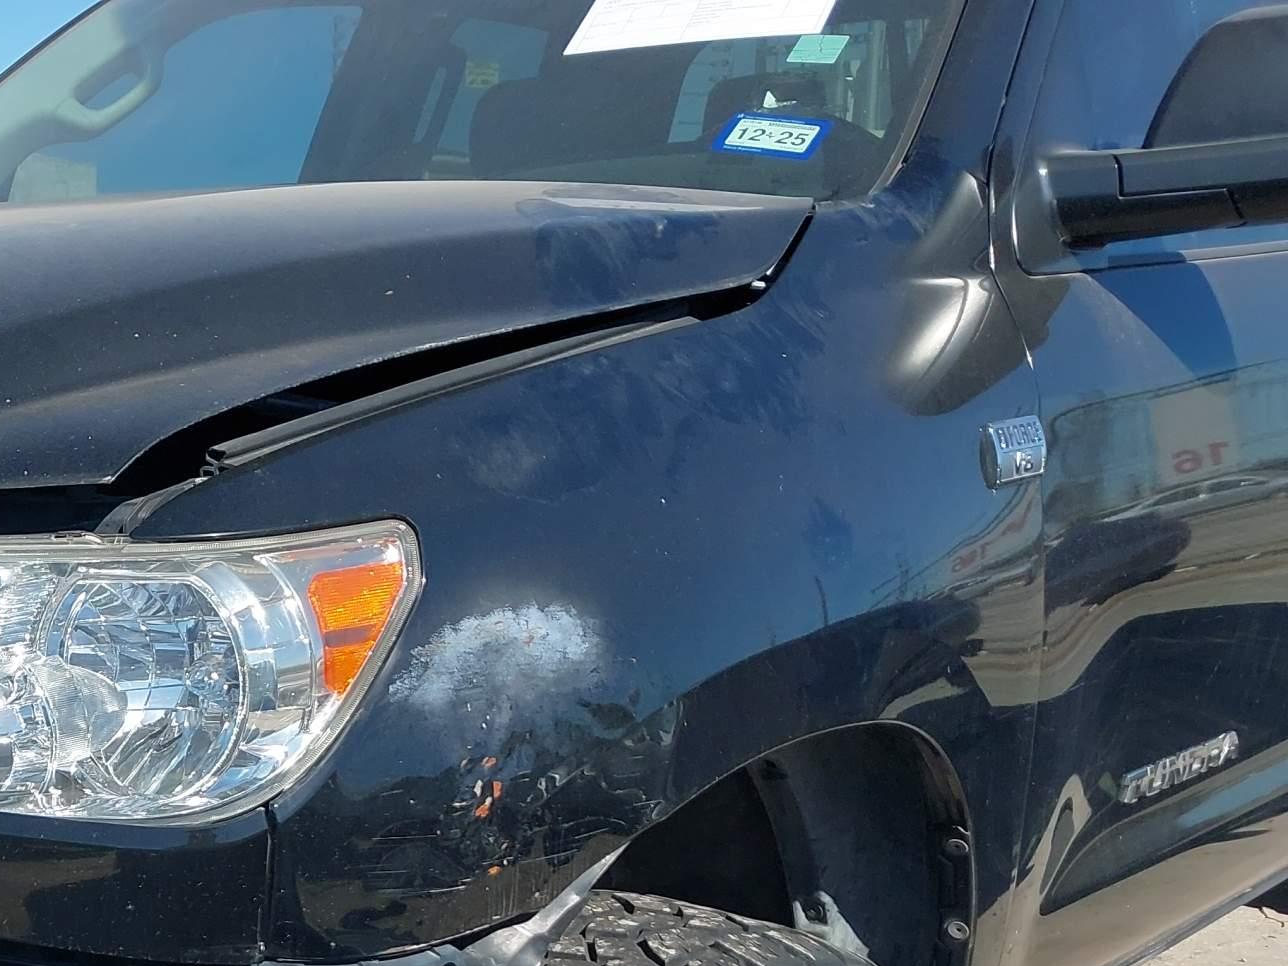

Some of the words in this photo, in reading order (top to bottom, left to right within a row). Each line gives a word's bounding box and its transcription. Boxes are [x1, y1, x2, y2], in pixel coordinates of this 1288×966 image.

[737, 127, 767, 143] 12
[773, 130, 810, 147] 25
[1120, 730, 1240, 804] TUNDRA
